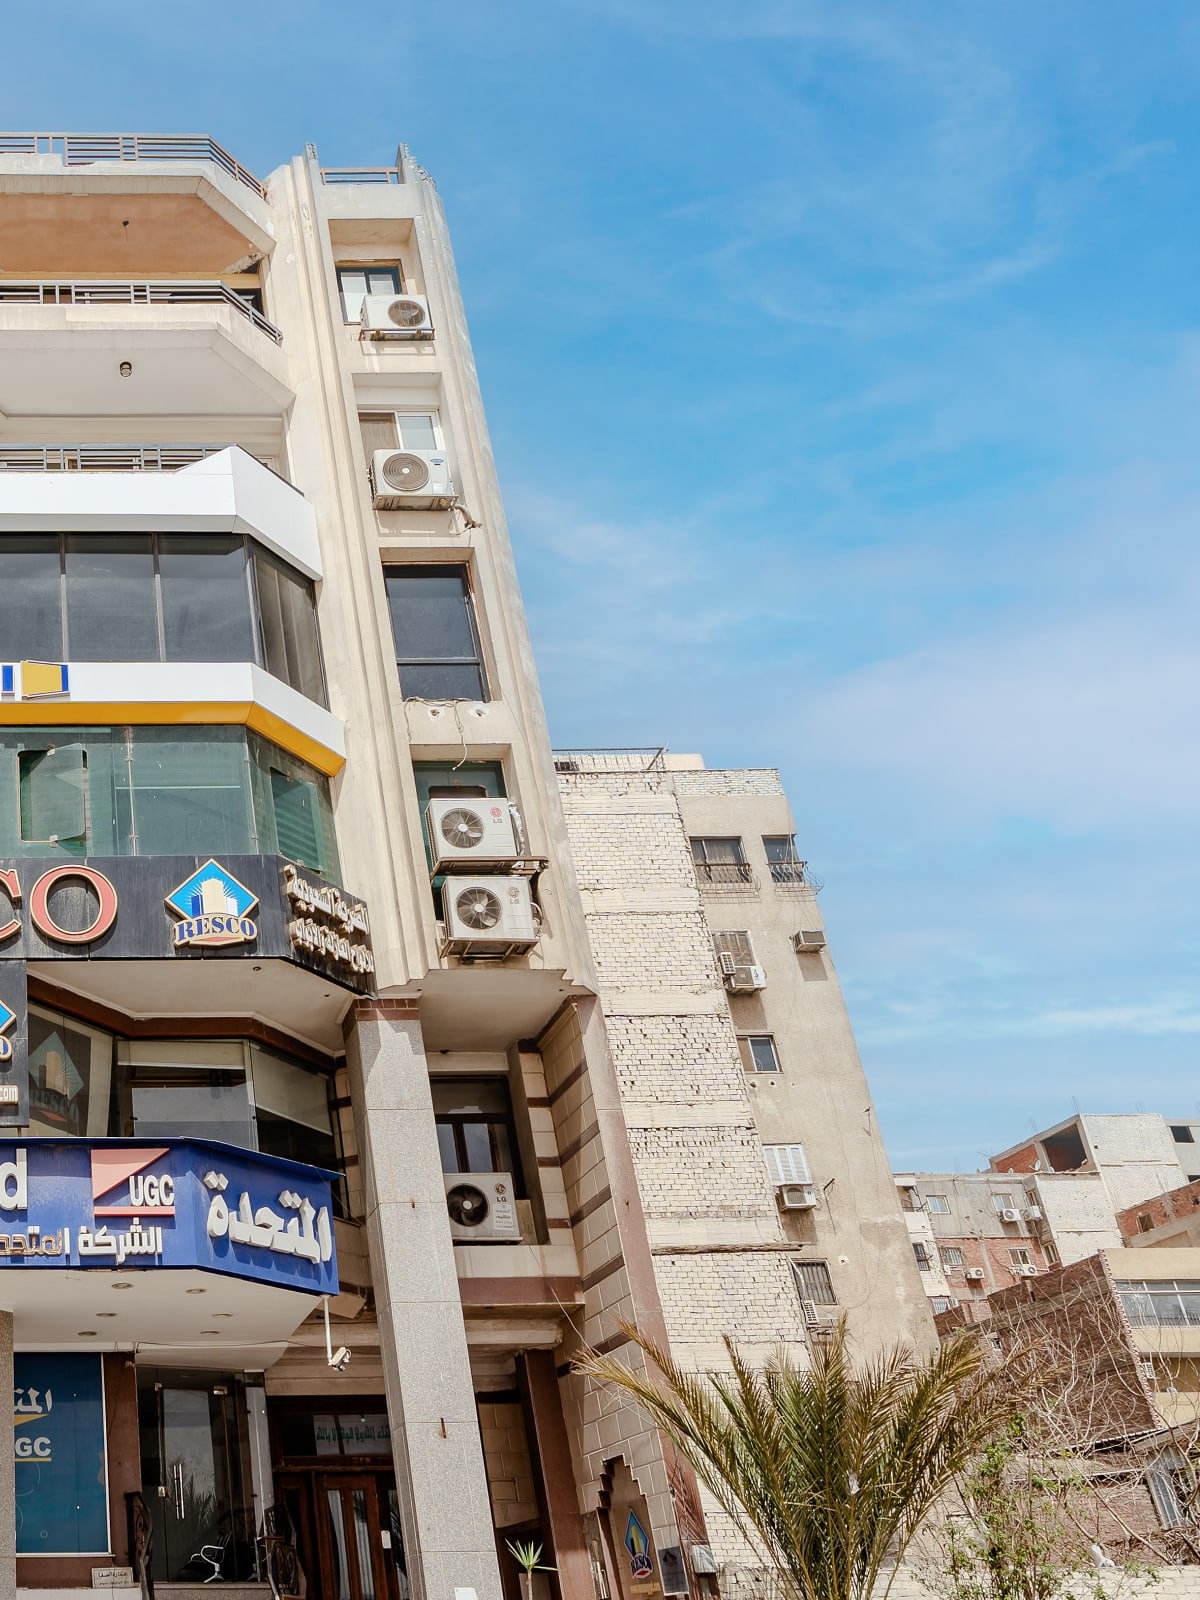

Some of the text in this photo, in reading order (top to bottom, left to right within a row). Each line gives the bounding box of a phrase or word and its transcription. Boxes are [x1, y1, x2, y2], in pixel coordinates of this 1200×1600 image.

[177, 915, 255, 942] RESCO
[129, 1174, 175, 1207] UGC
[207, 1170, 332, 1264] المتحدة
[78, 1216, 163, 1265] الشركة
[14, 1436, 52, 1457] GC
